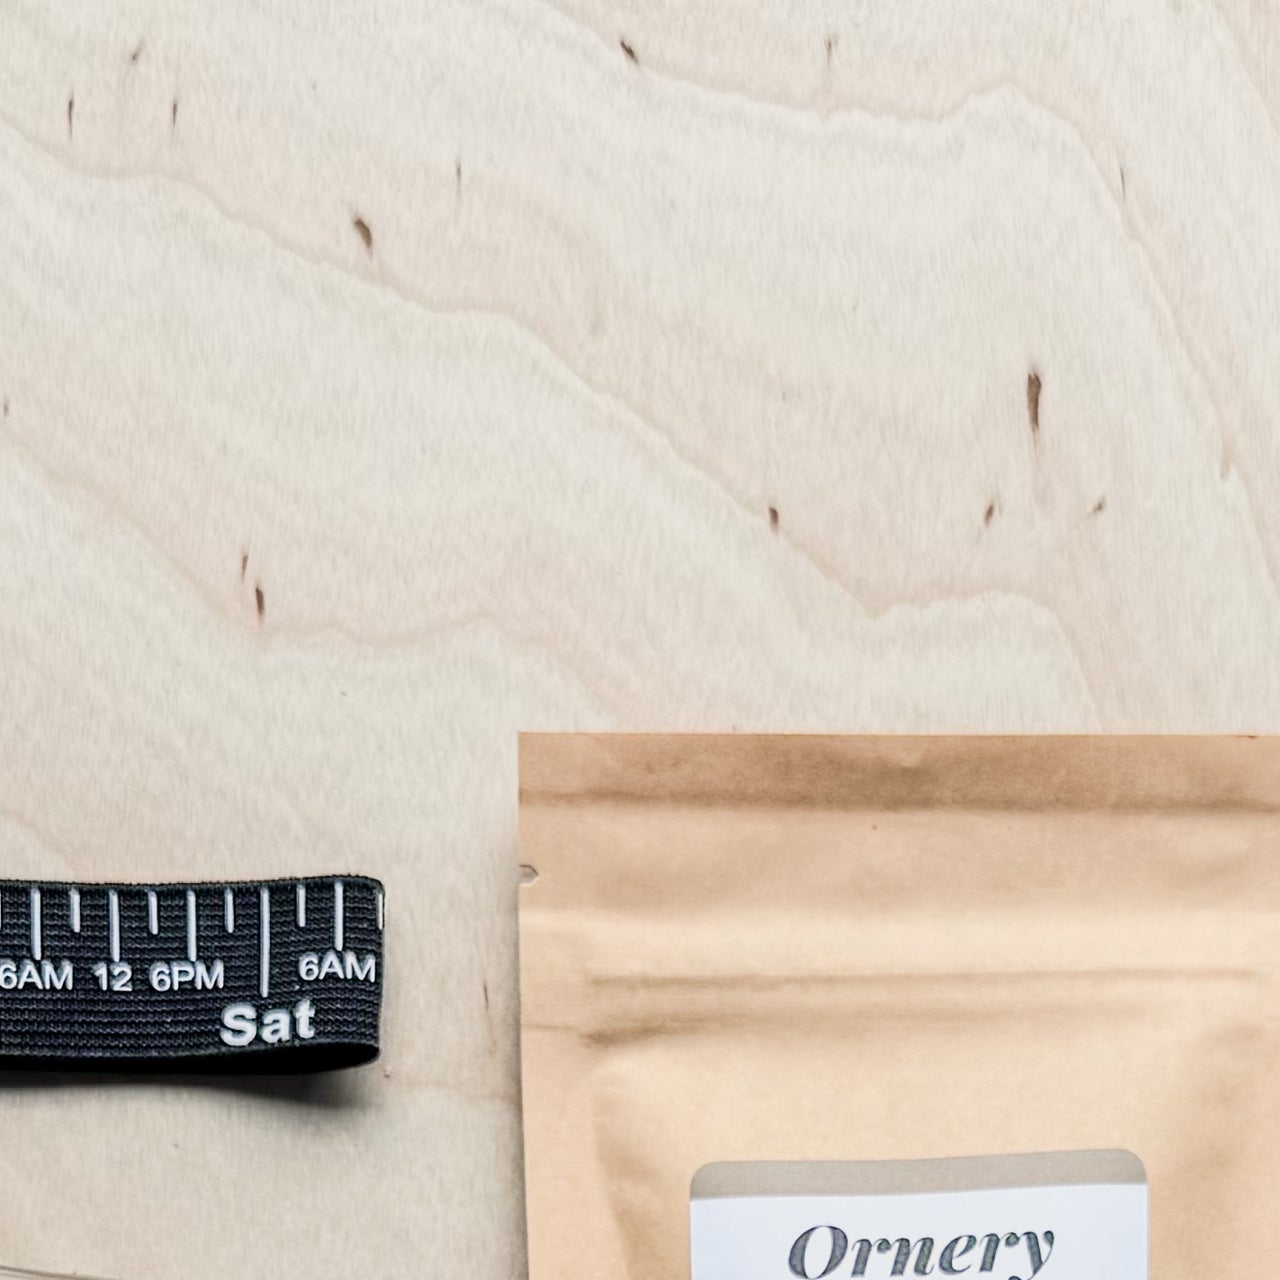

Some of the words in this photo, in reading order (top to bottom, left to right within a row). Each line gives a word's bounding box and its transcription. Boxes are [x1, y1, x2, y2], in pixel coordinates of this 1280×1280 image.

[93, 967, 133, 991] 12
[148, 961, 224, 992] 6PM
[298, 953, 376, 982] 6AM
[222, 999, 315, 1044] Sat
